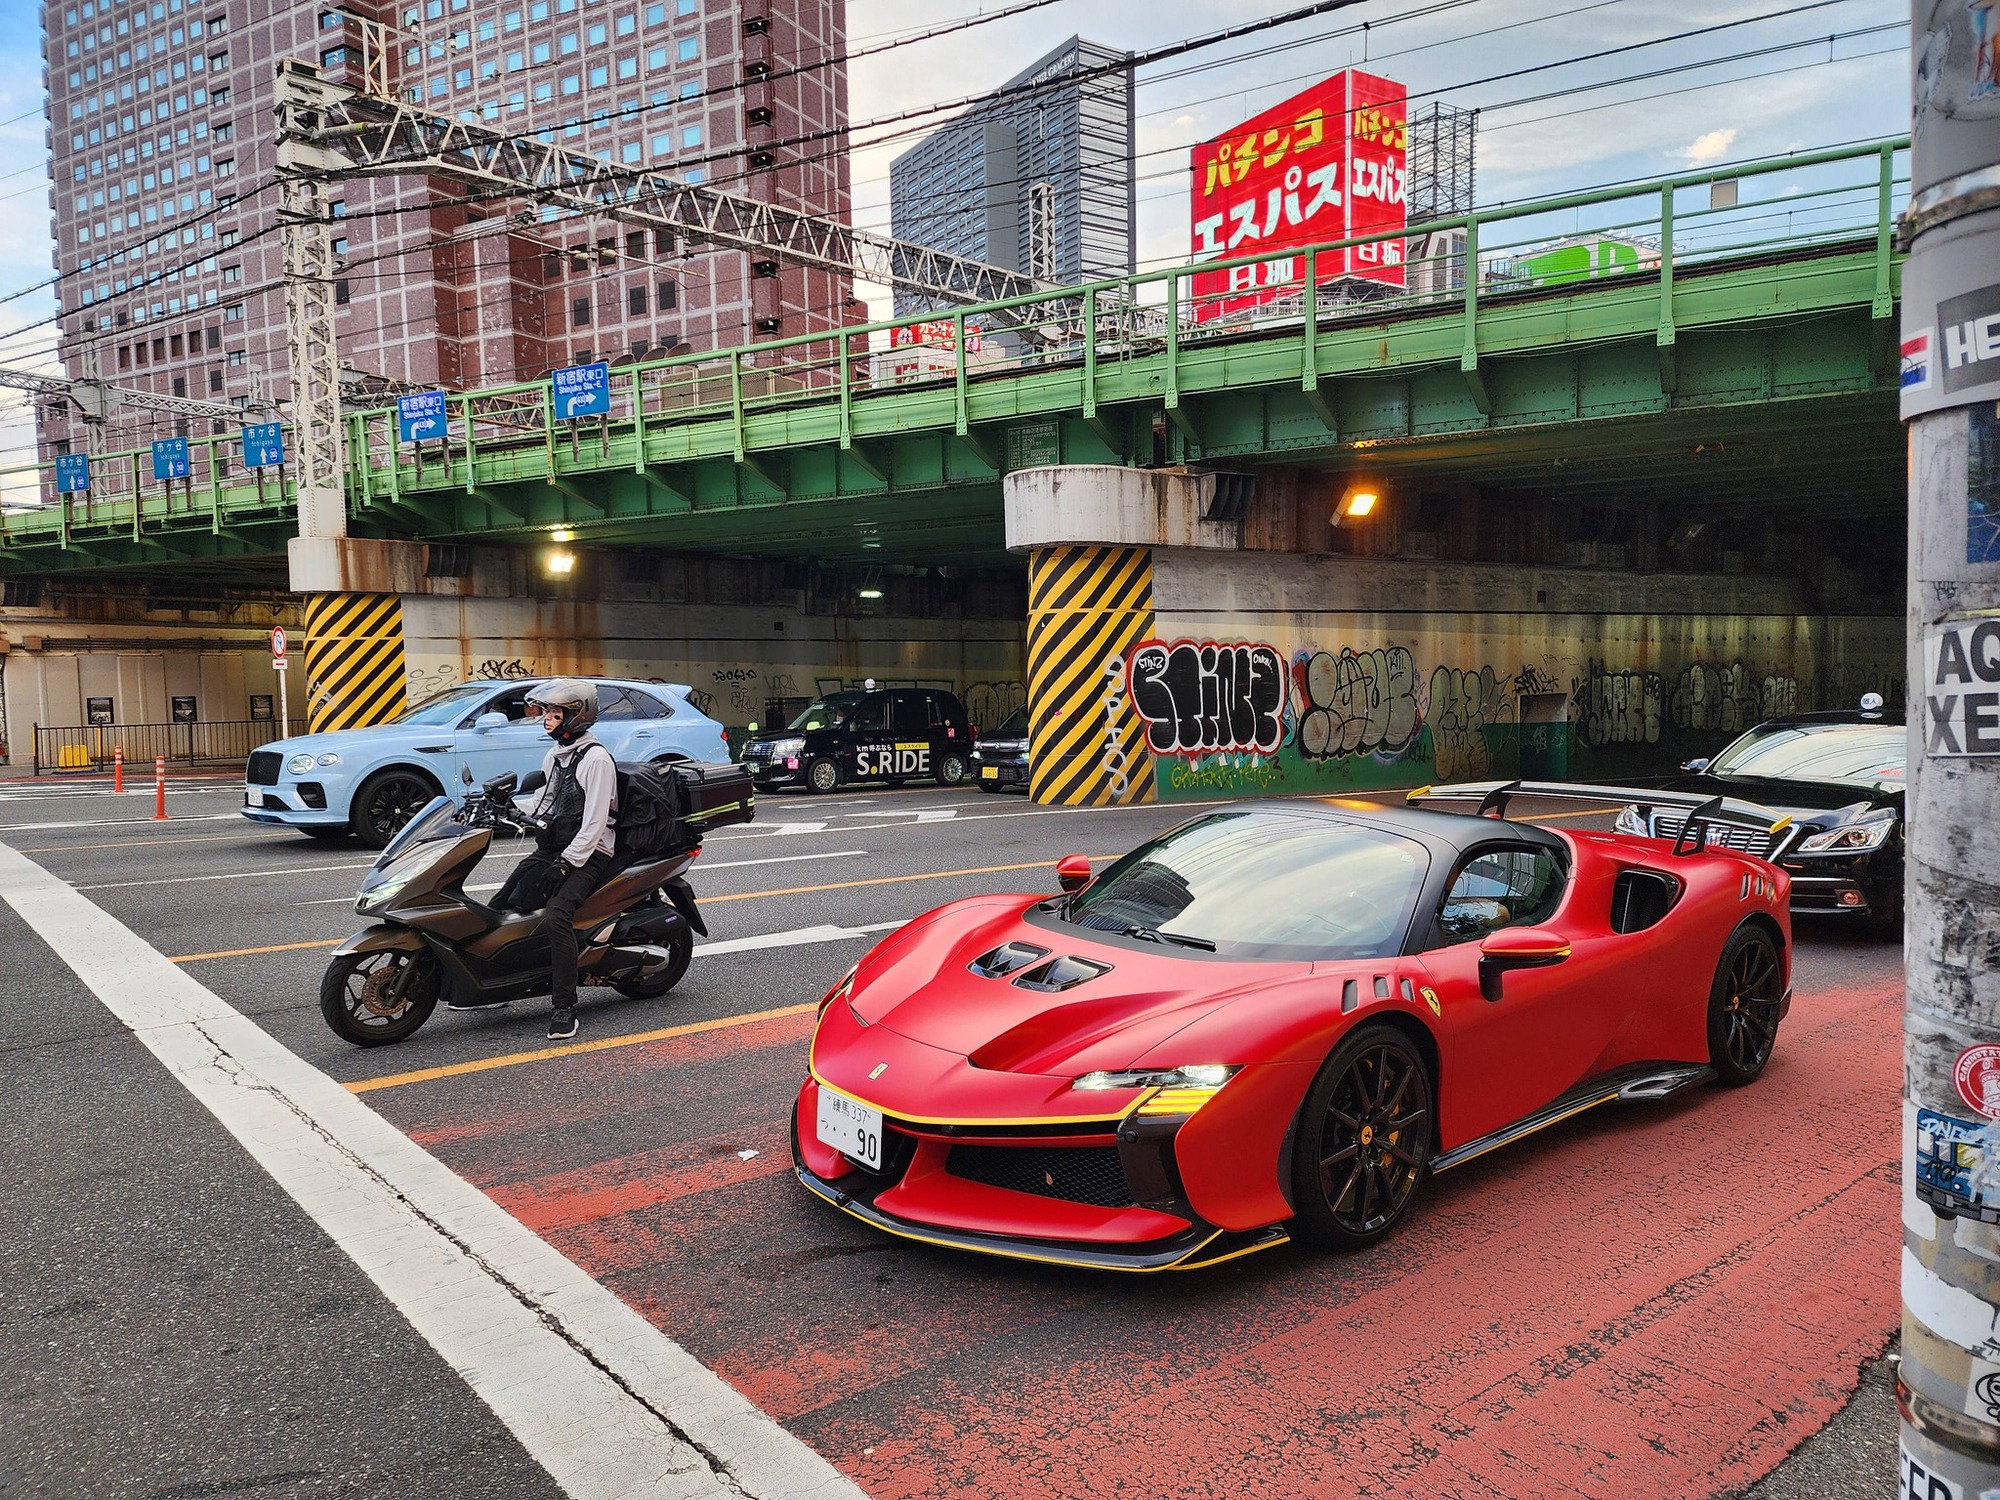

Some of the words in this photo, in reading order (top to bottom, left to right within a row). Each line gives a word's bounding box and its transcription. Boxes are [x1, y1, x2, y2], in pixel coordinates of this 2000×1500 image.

[1354, 102, 1407, 150] パチンコ
[1203, 108, 1323, 197] パチンコ
[1352, 156, 1407, 206] エスパス
[1193, 162, 1342, 264] エスパス
[556, 368, 604, 385] 新宿駅東口
[401, 395, 442, 411] 新宿駅東口
[1936, 621, 2000, 685] AQ
[1927, 693, 2000, 753] XE
[856, 750, 930, 776] S.RIDE
[851, 1105, 868, 1124] 337
